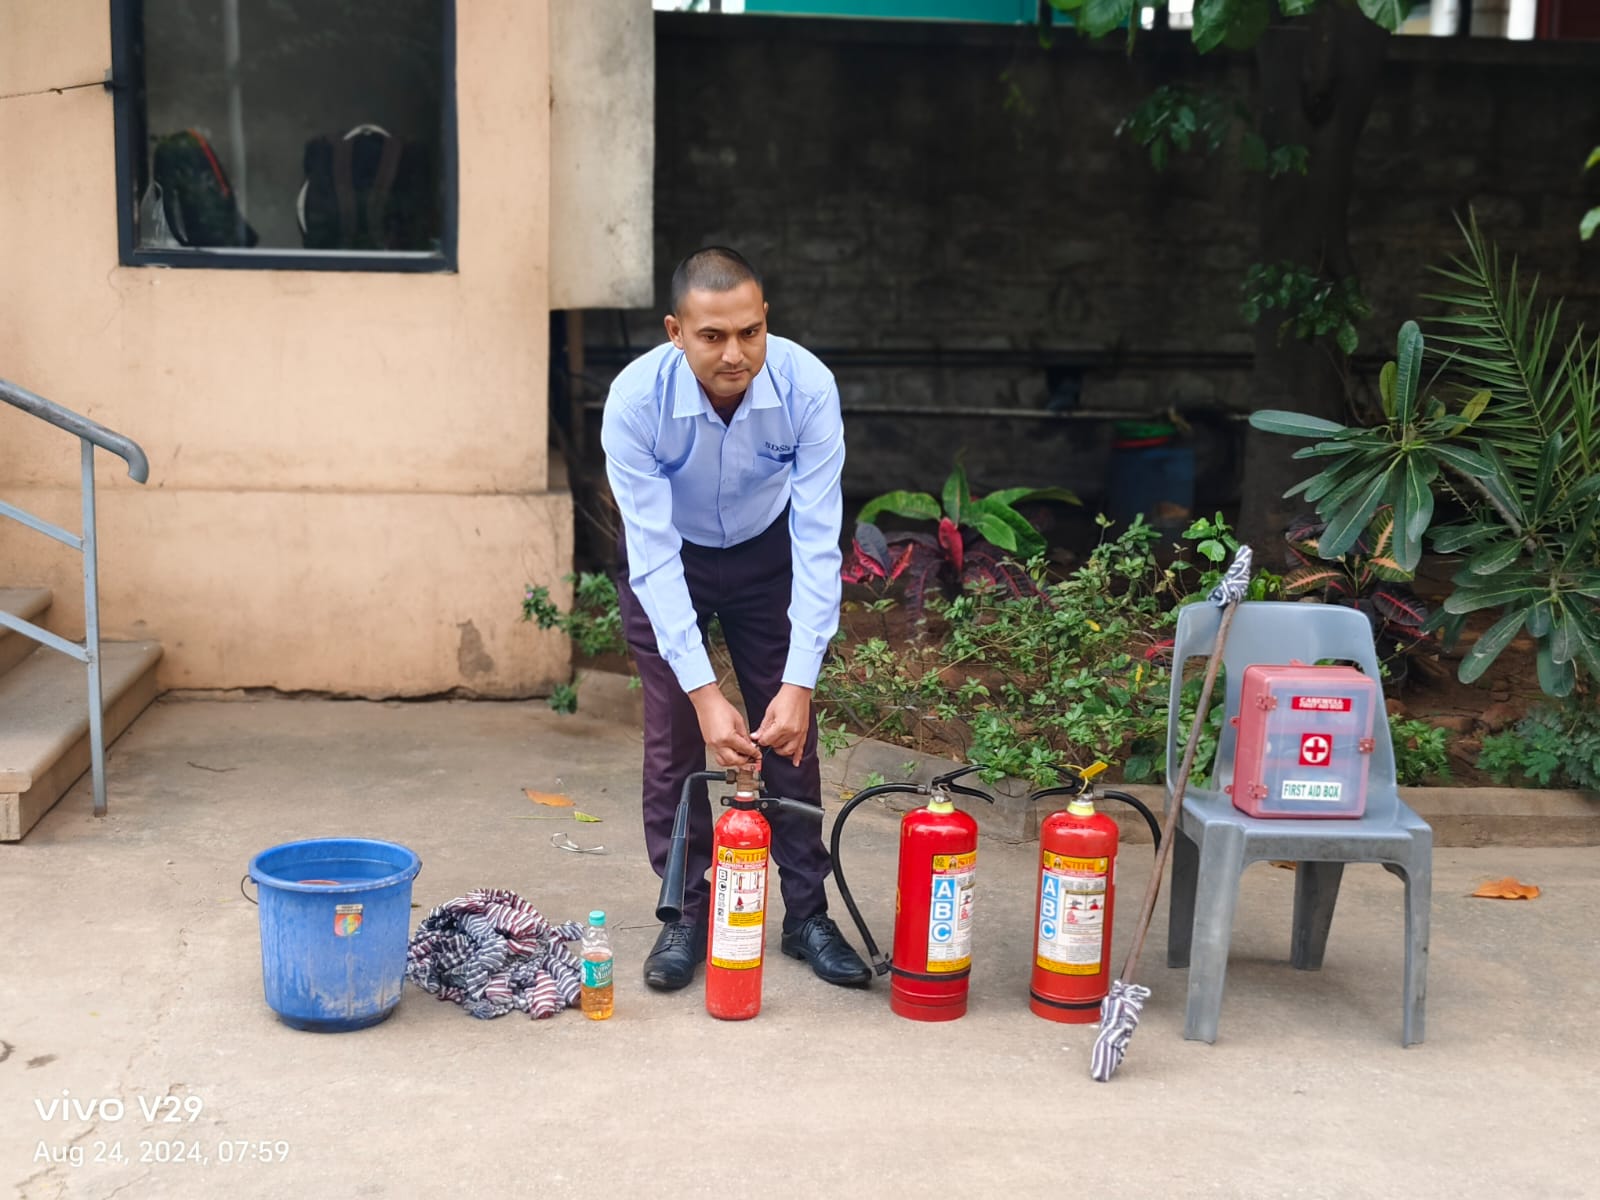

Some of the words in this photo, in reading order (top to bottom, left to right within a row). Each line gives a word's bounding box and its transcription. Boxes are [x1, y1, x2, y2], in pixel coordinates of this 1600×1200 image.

[1283, 783, 1306, 797] FIRST
[1307, 784, 1322, 797] AID
[1323, 785, 1340, 798] BOX
[936, 881, 953, 898] A
[1044, 880, 1057, 897] A
[938, 903, 952, 919] B
[1043, 900, 1055, 917] B
[933, 924, 951, 941] C
[1041, 923, 1055, 938] C
